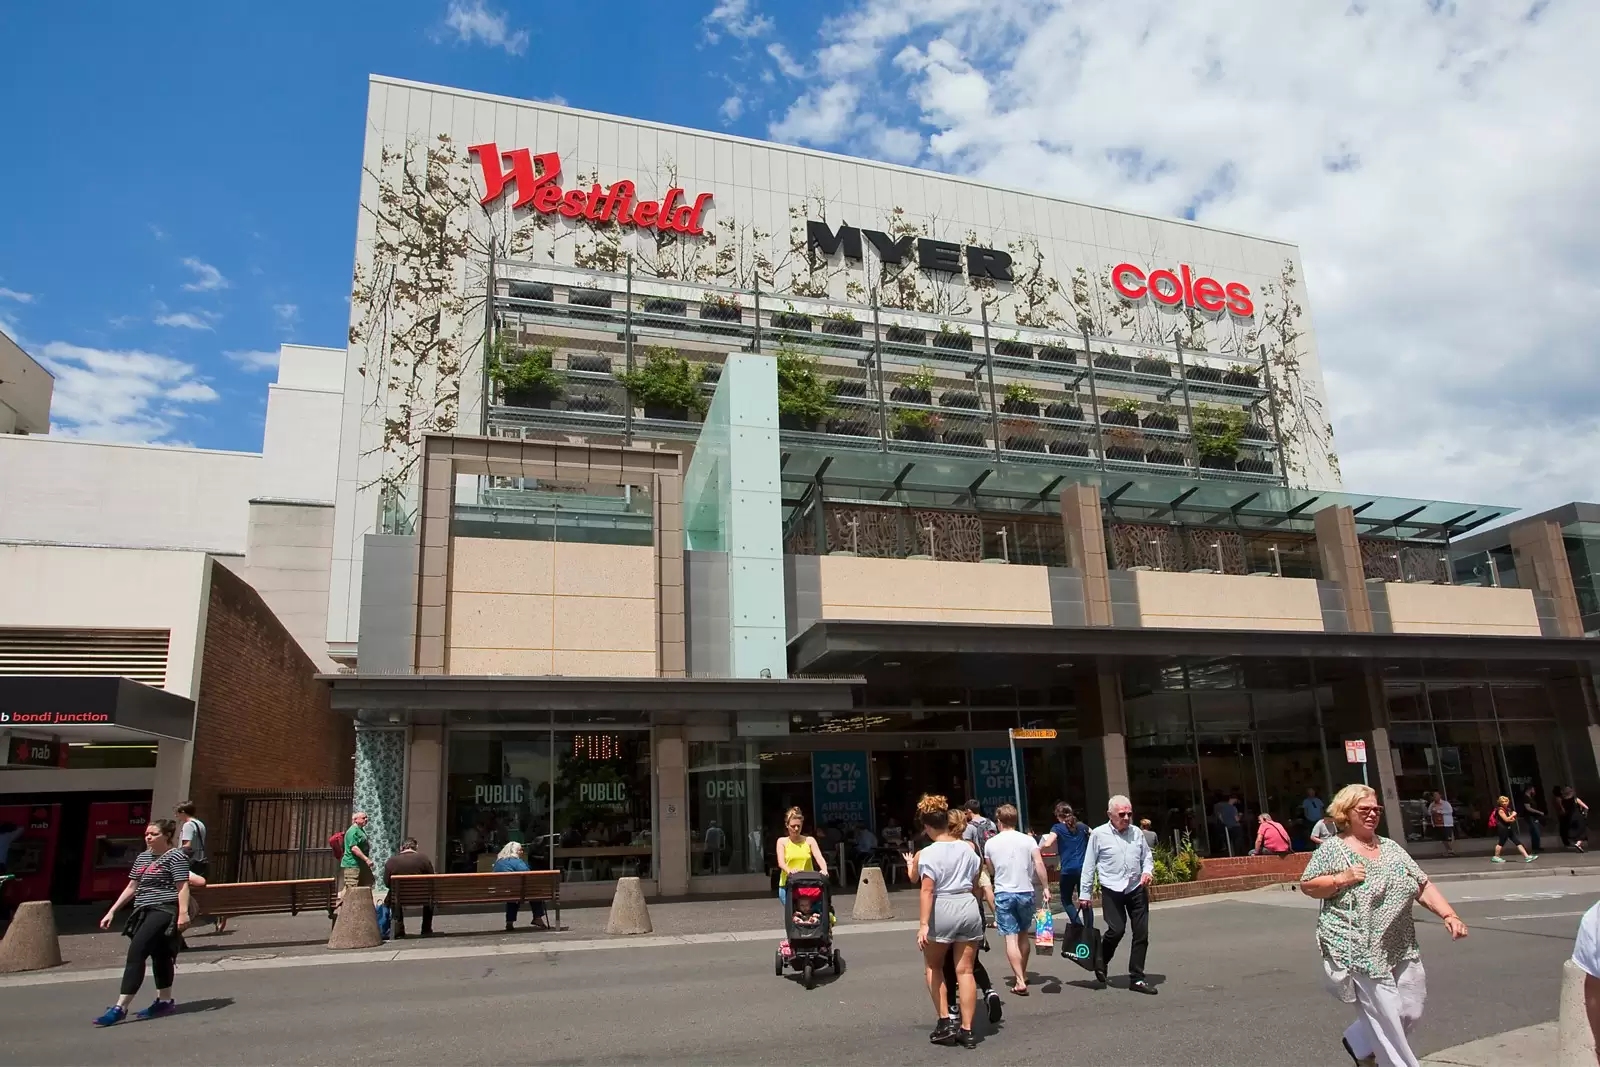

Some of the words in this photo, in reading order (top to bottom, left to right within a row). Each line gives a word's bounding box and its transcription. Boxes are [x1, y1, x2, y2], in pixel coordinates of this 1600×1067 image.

[467, 142, 714, 235] Westfield
[807, 219, 1014, 281] MYER
[1111, 263, 1254, 317] coles
[12, 712, 52, 722] bondi
[53, 712, 108, 723] junction
[31, 744, 50, 760] nab
[820, 763, 861, 780] 25%
[706, 780, 745, 799] OPEN
[826, 779, 857, 794] OFF
[986, 775, 1013, 789] OFF
[475, 784, 525, 805] PUBLIC
[580, 782, 626, 802] PUBLIC
[30, 821, 49, 829] nab
